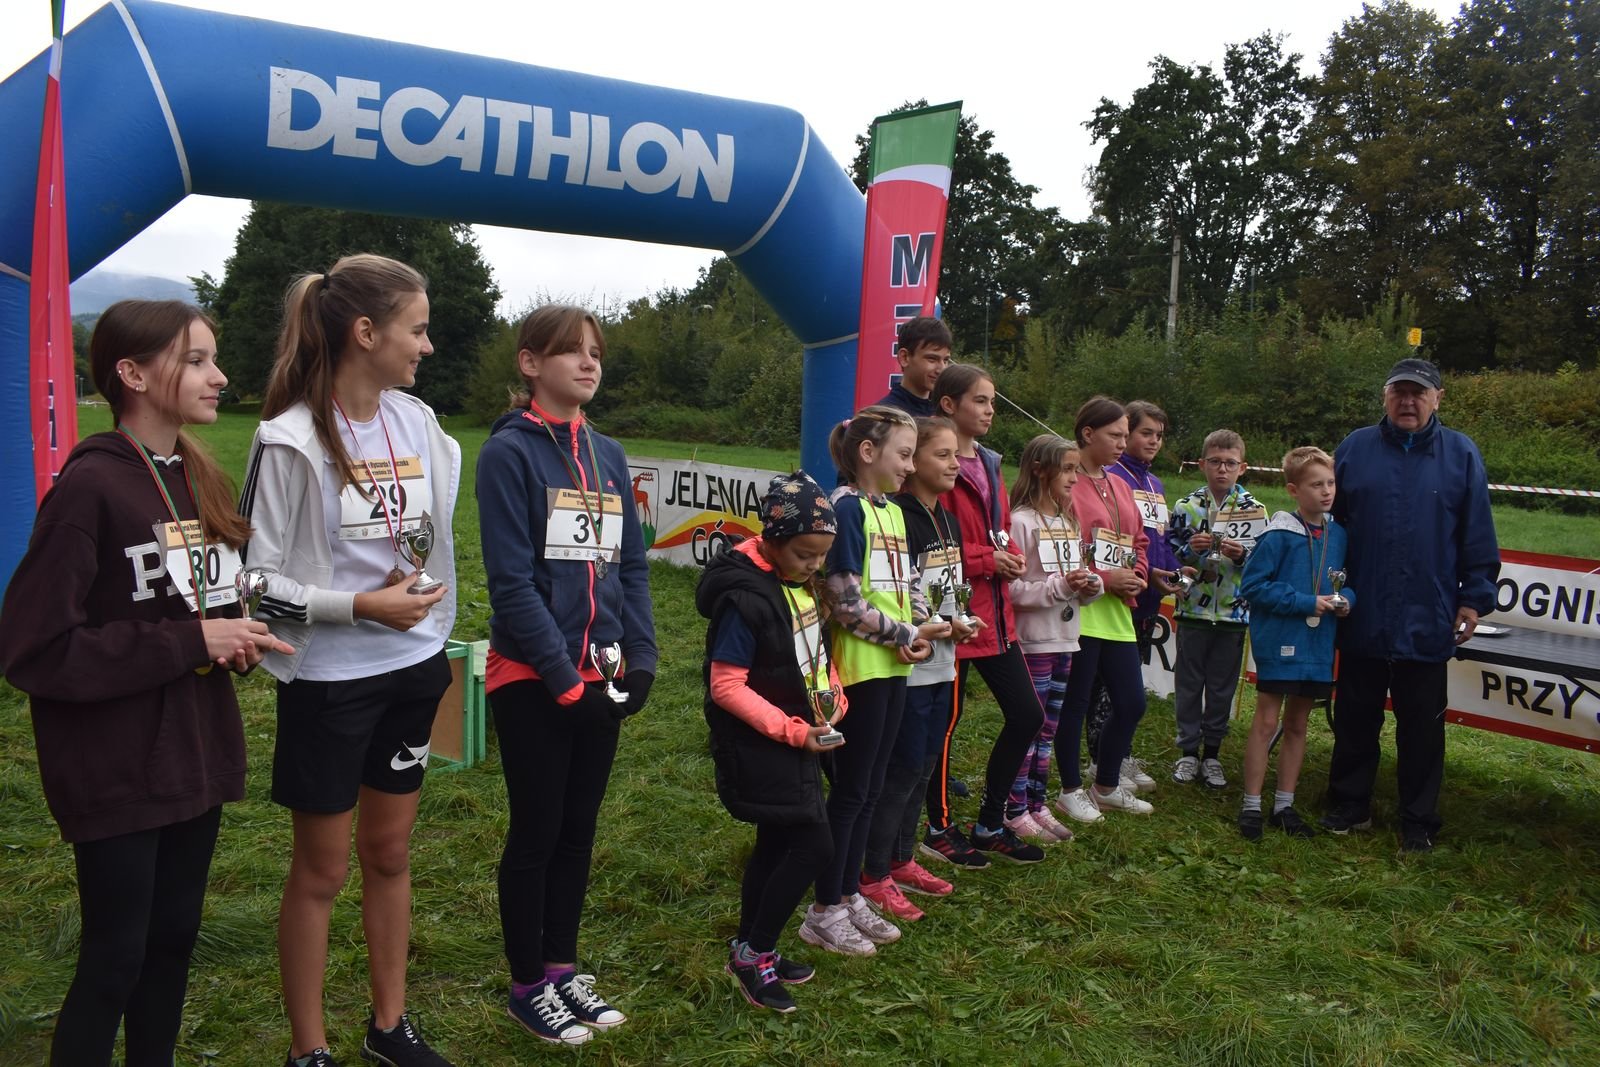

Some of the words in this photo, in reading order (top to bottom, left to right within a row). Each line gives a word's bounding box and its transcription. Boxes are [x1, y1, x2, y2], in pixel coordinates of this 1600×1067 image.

[267, 66, 735, 203] DECATHLON
[369, 483, 407, 519] 29
[665, 470, 763, 521] JELENIA
[1144, 503, 1159, 520] 34
[1053, 541, 1071, 560] 18
[1228, 522, 1252, 539] 32
[188, 547, 221, 590] 30
[1495, 578, 1600, 625] OGNI
[1481, 670, 1585, 720] PRZY
